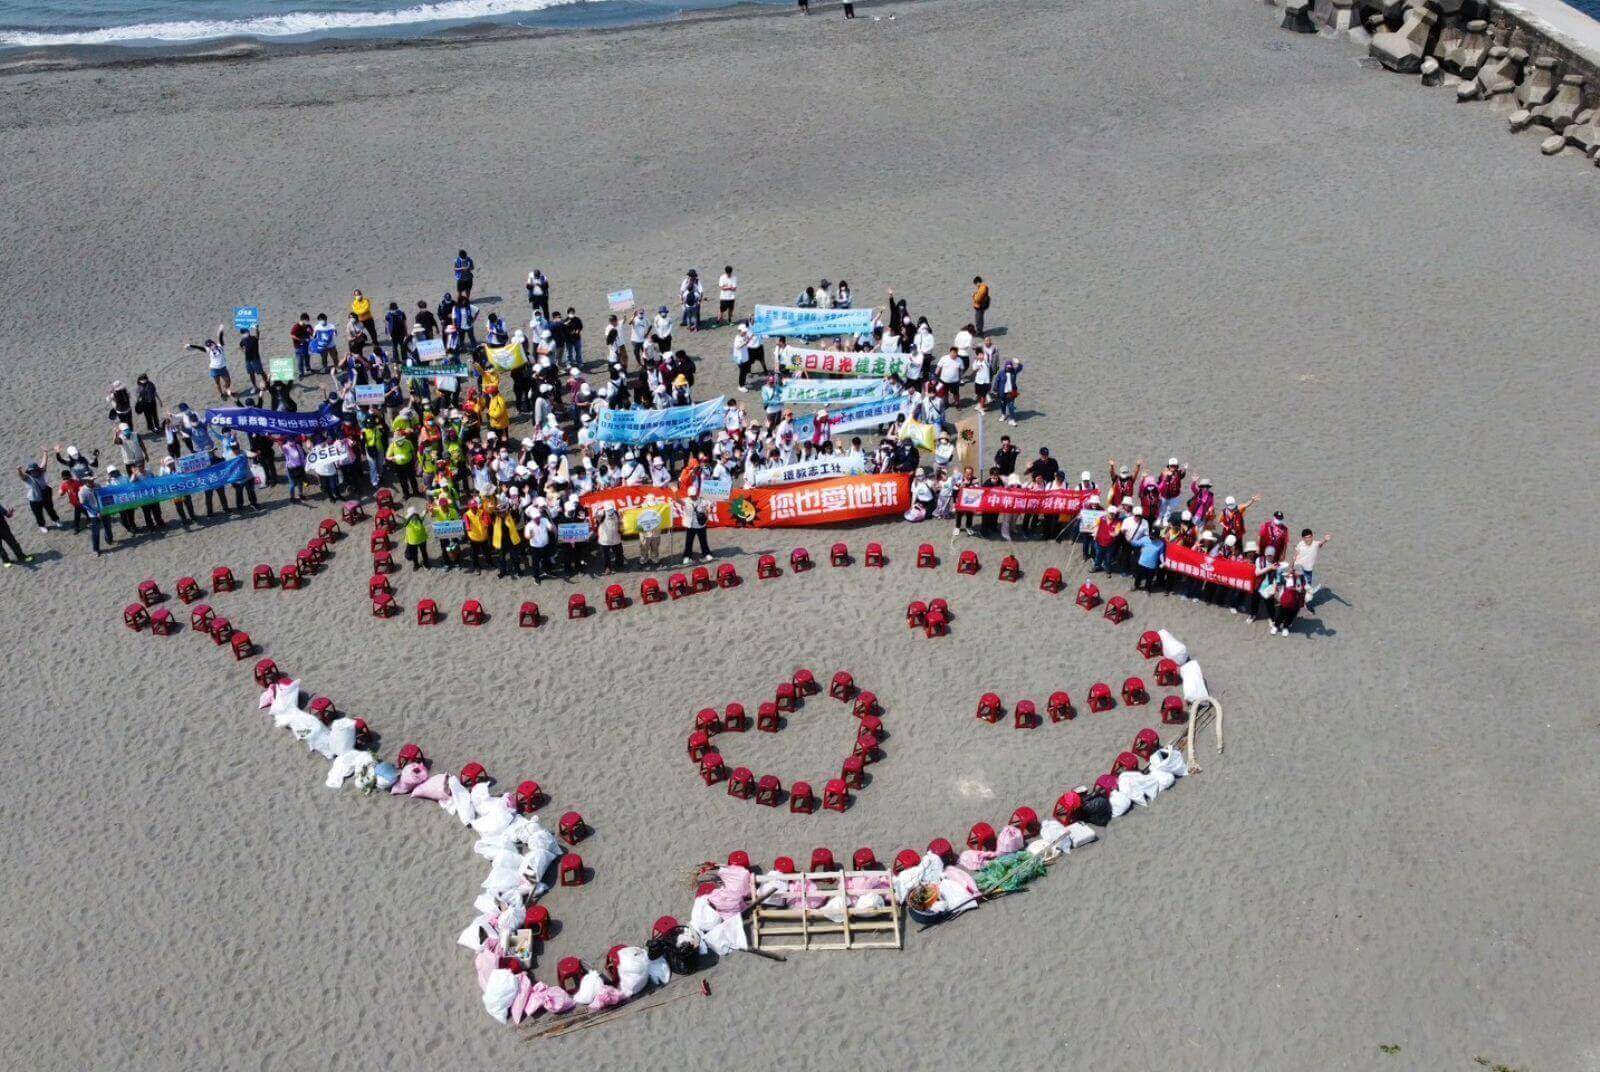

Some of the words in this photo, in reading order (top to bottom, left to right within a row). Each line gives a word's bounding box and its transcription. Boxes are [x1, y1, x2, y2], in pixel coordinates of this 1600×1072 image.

[211, 415, 233, 425] OSE
[783, 462, 842, 482] 環教志工社
[769, 480, 899, 521] 您也愛地球
